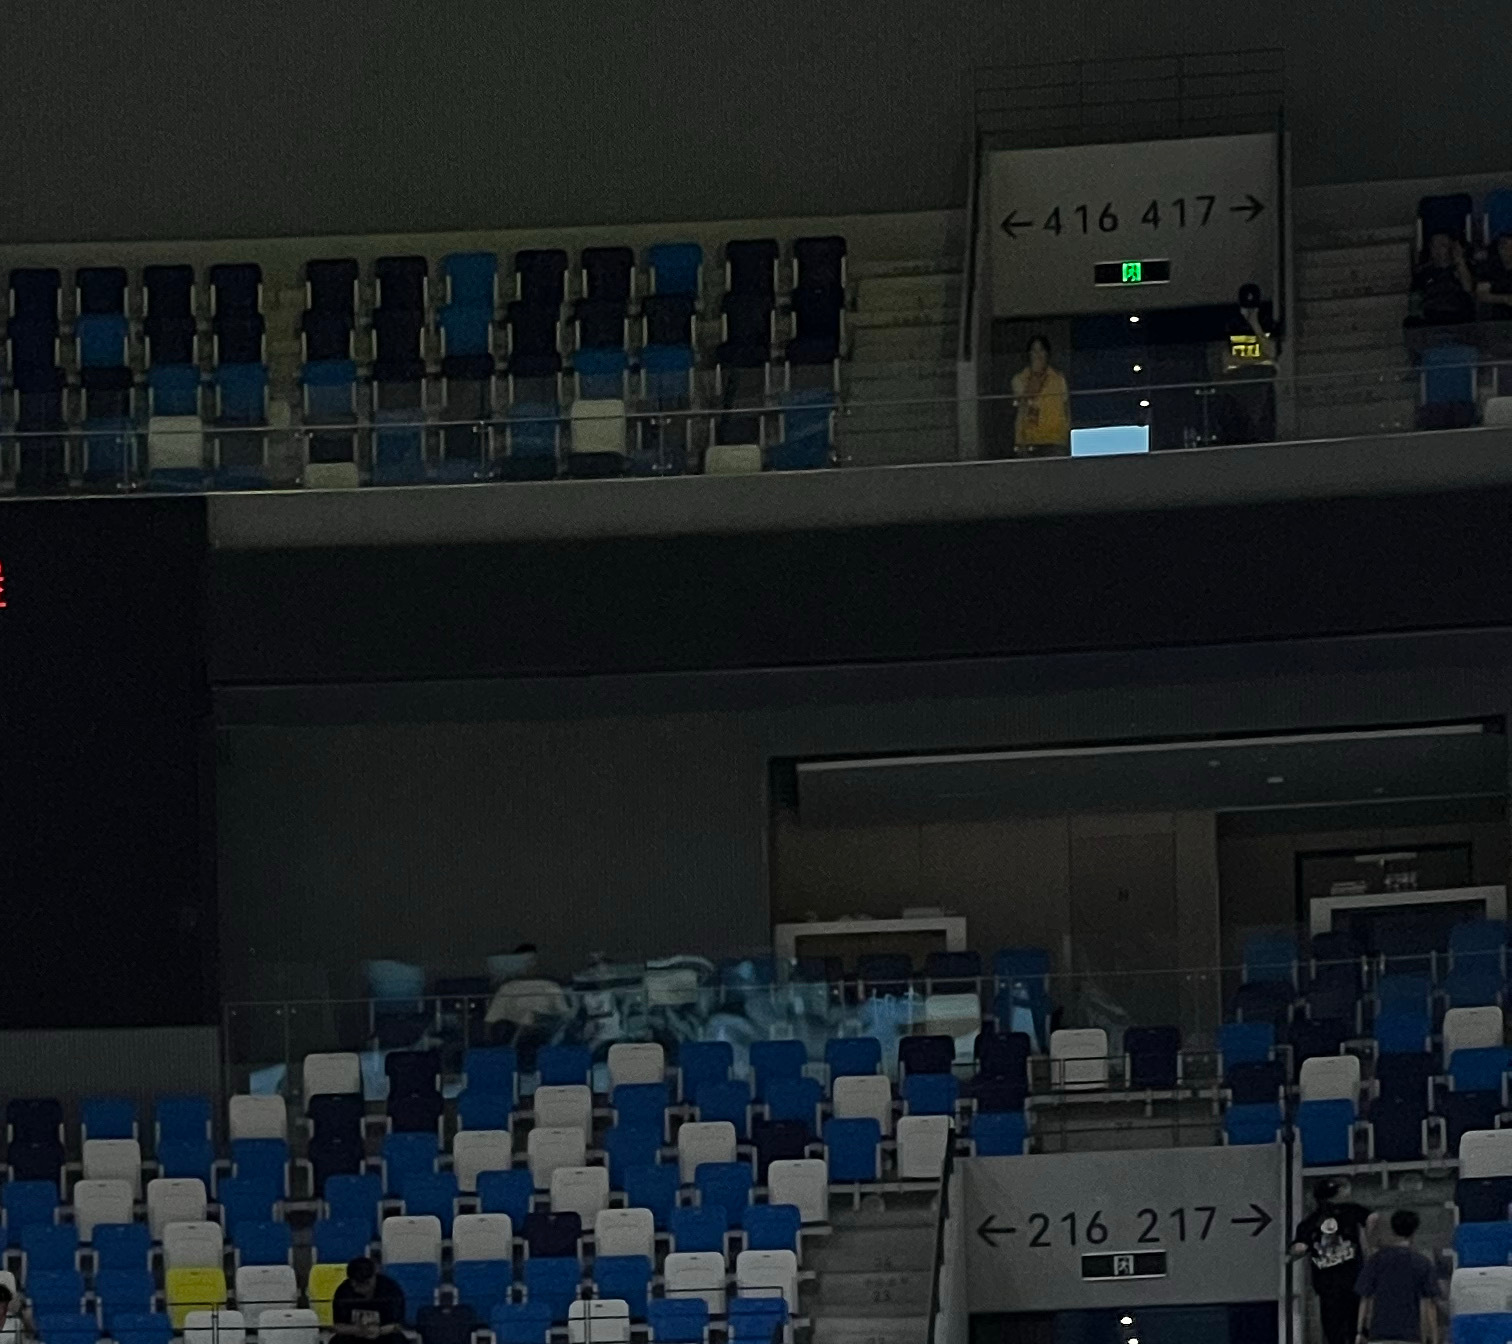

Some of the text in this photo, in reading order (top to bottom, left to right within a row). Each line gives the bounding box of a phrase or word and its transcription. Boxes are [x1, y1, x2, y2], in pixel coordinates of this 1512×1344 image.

[1042, 194, 1217, 237] 416 417
[1029, 1206, 1217, 1248] 216 217
